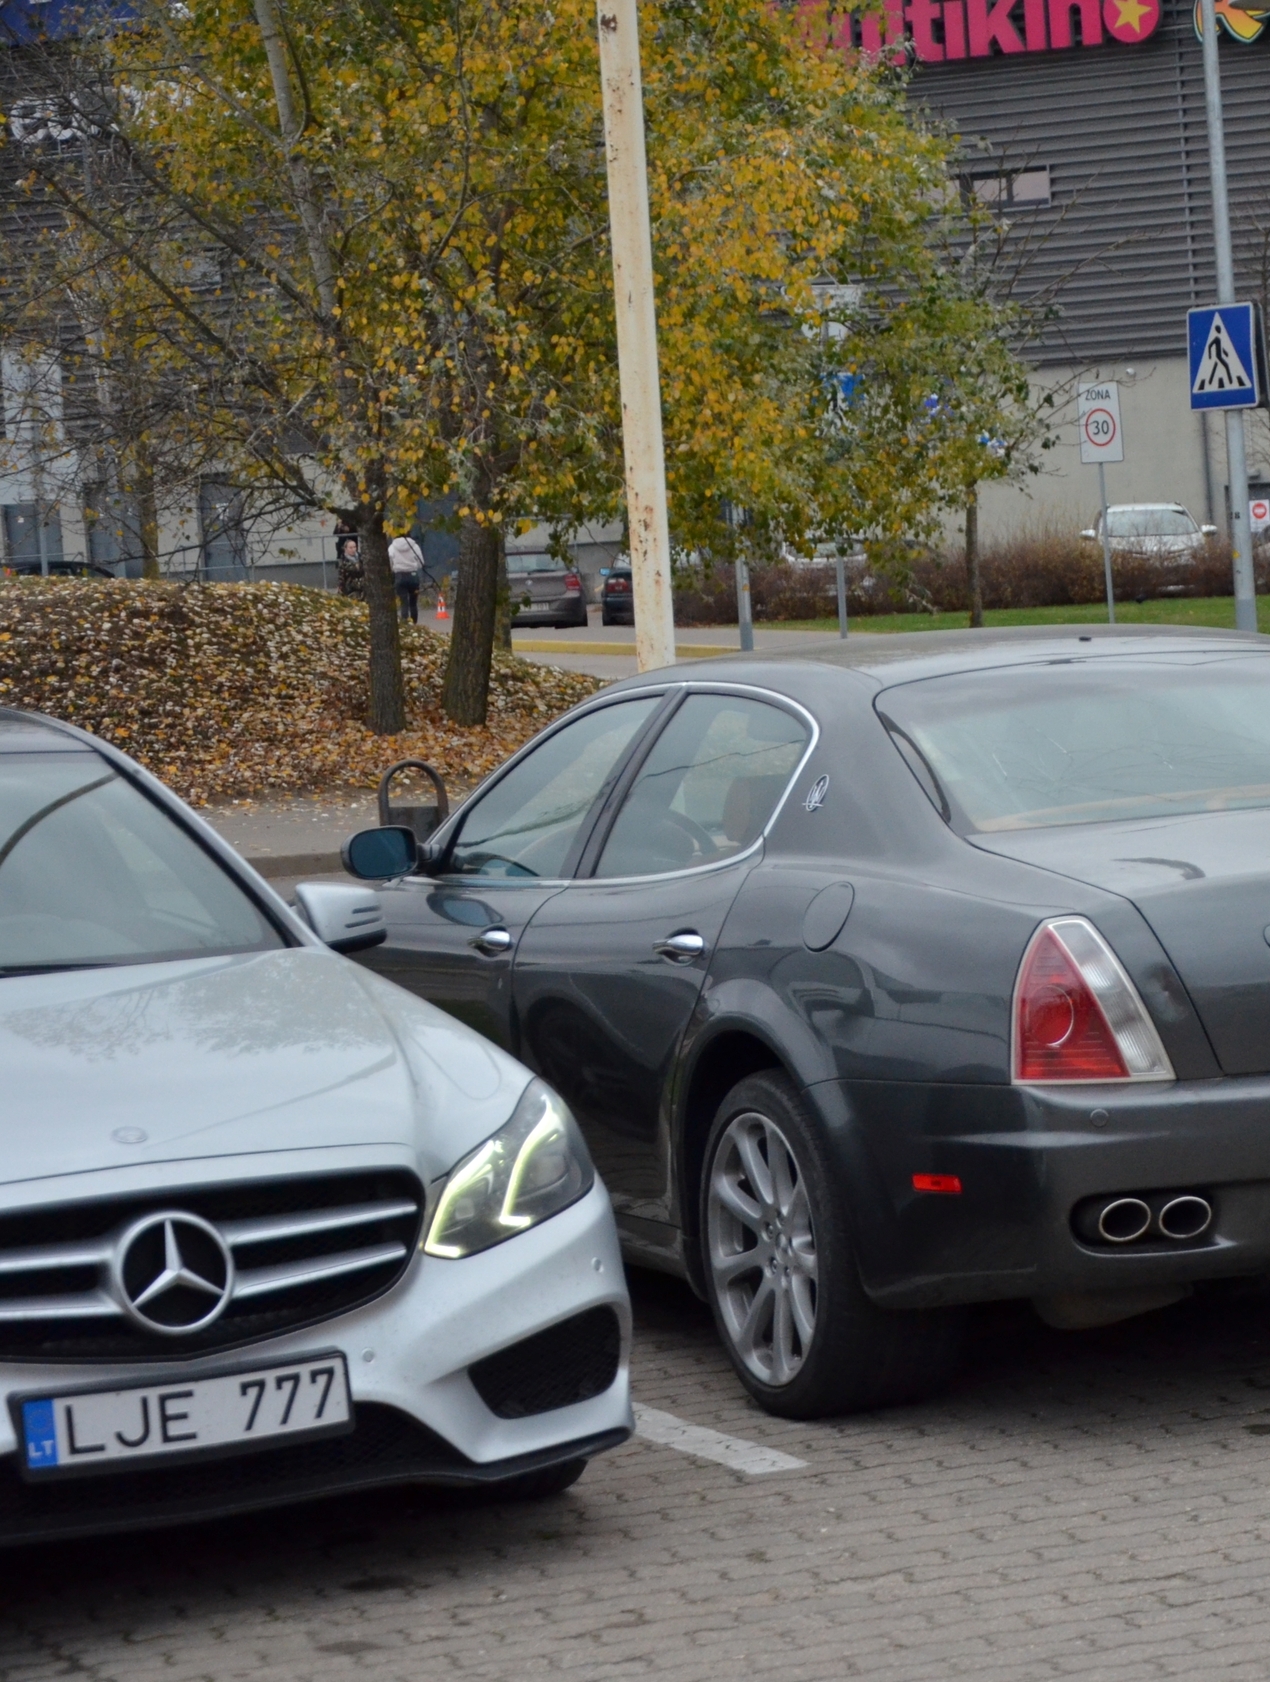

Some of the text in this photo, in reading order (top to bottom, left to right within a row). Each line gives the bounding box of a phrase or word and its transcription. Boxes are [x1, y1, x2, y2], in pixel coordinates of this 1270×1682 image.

[1085, 389, 1111, 401] ZONA
[1092, 420, 1110, 435] 30
[65, 1365, 336, 1456] LJE 777
[28, 1439, 54, 1458] LT
